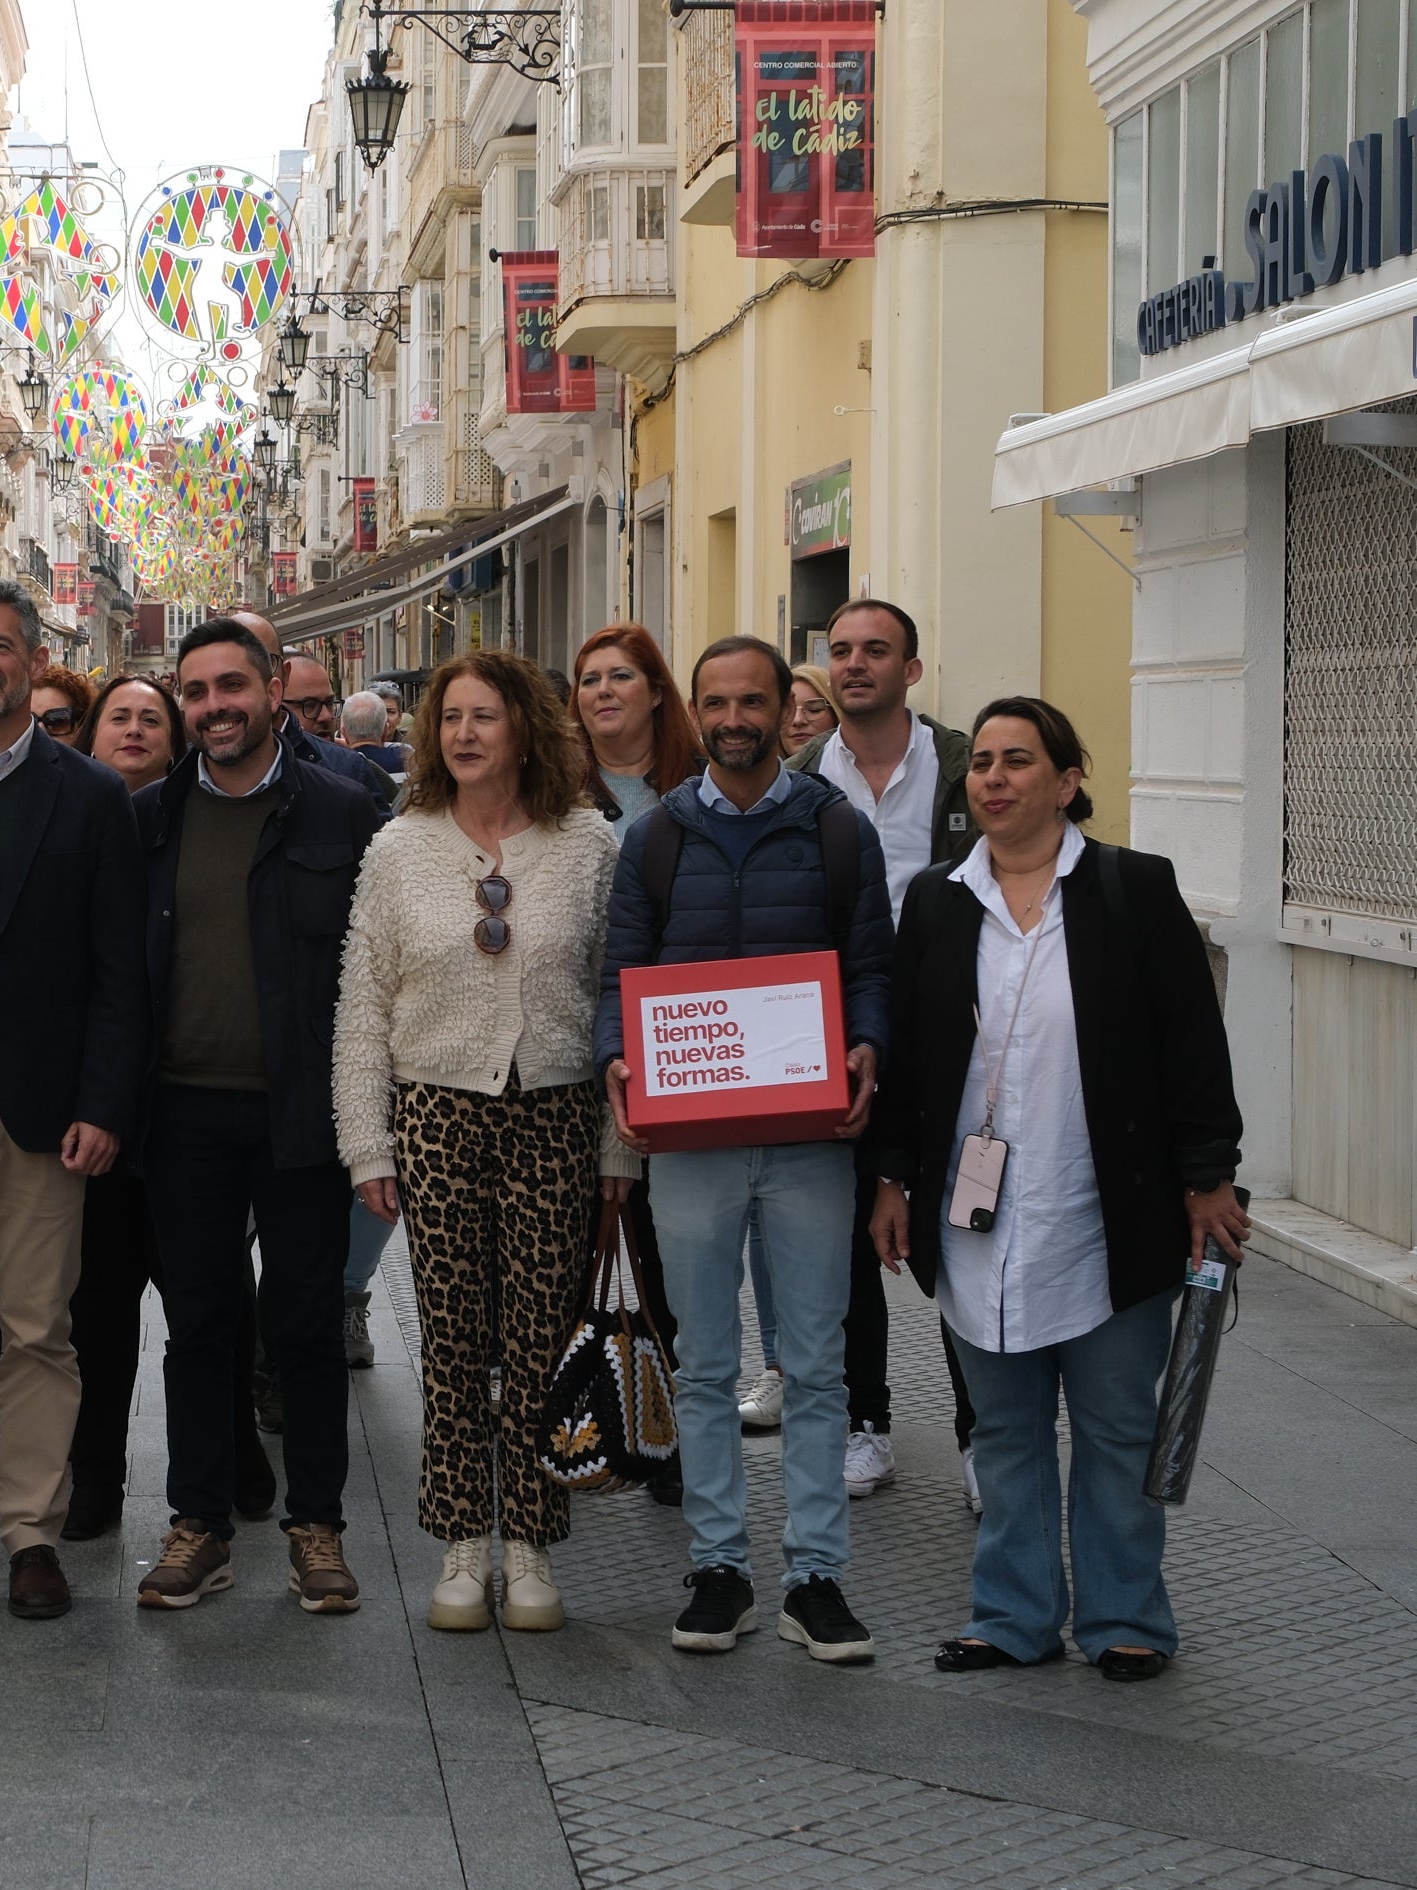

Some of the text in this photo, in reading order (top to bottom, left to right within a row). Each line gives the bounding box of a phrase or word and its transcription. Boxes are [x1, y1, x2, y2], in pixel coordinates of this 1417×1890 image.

[754, 61, 857, 69] CENTRO COMERCIAL ABIERTO
[755, 84, 862, 124] El latido
[751, 123, 862, 157] de Cádiz
[1243, 132, 1383, 314] SALON
[517, 308, 533, 327] El
[514, 329, 536, 348] de
[652, 999, 728, 1022] nuevo
[653, 1021, 745, 1044] tiempo,
[656, 1043, 745, 1066] nuevas
[657, 1065, 750, 1088] formas.
[785, 1067, 806, 1076] PSOE
